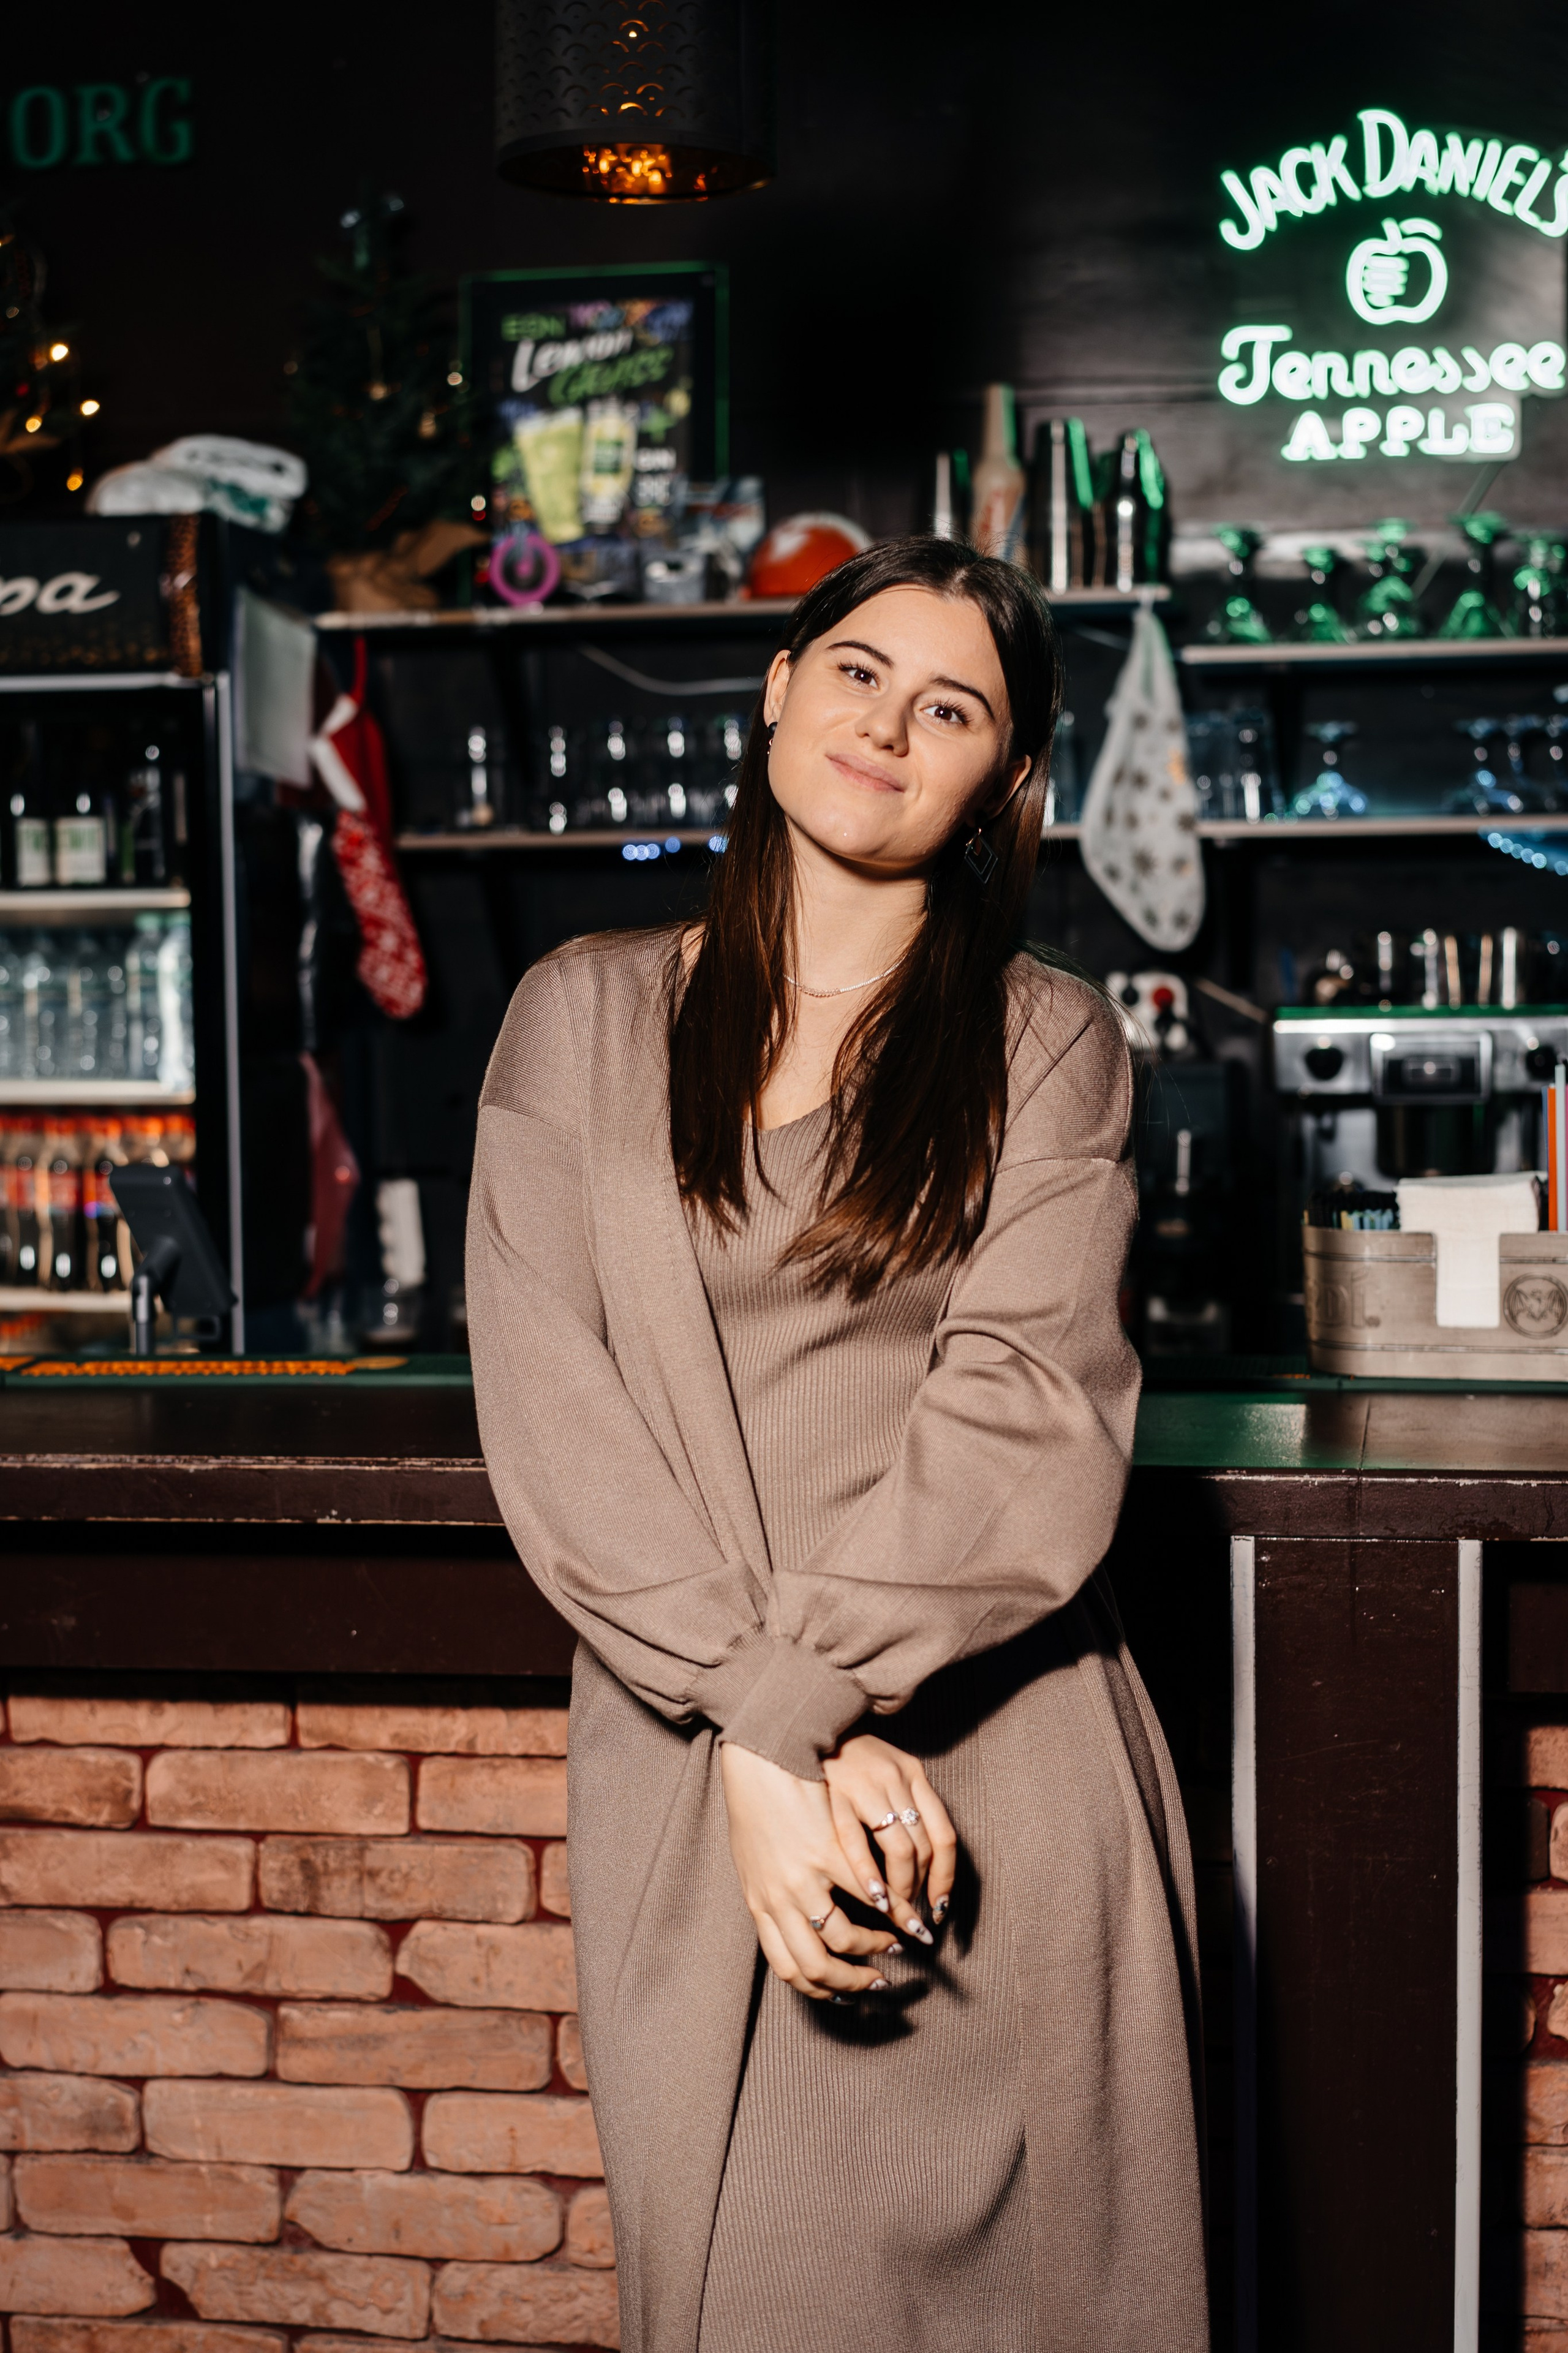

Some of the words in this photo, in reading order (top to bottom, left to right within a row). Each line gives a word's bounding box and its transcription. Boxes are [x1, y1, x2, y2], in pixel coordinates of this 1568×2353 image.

[1219, 134, 1362, 250] JACK
[1218, 325, 1566, 405] Tennessee
[1281, 402, 1515, 461] APPLE
